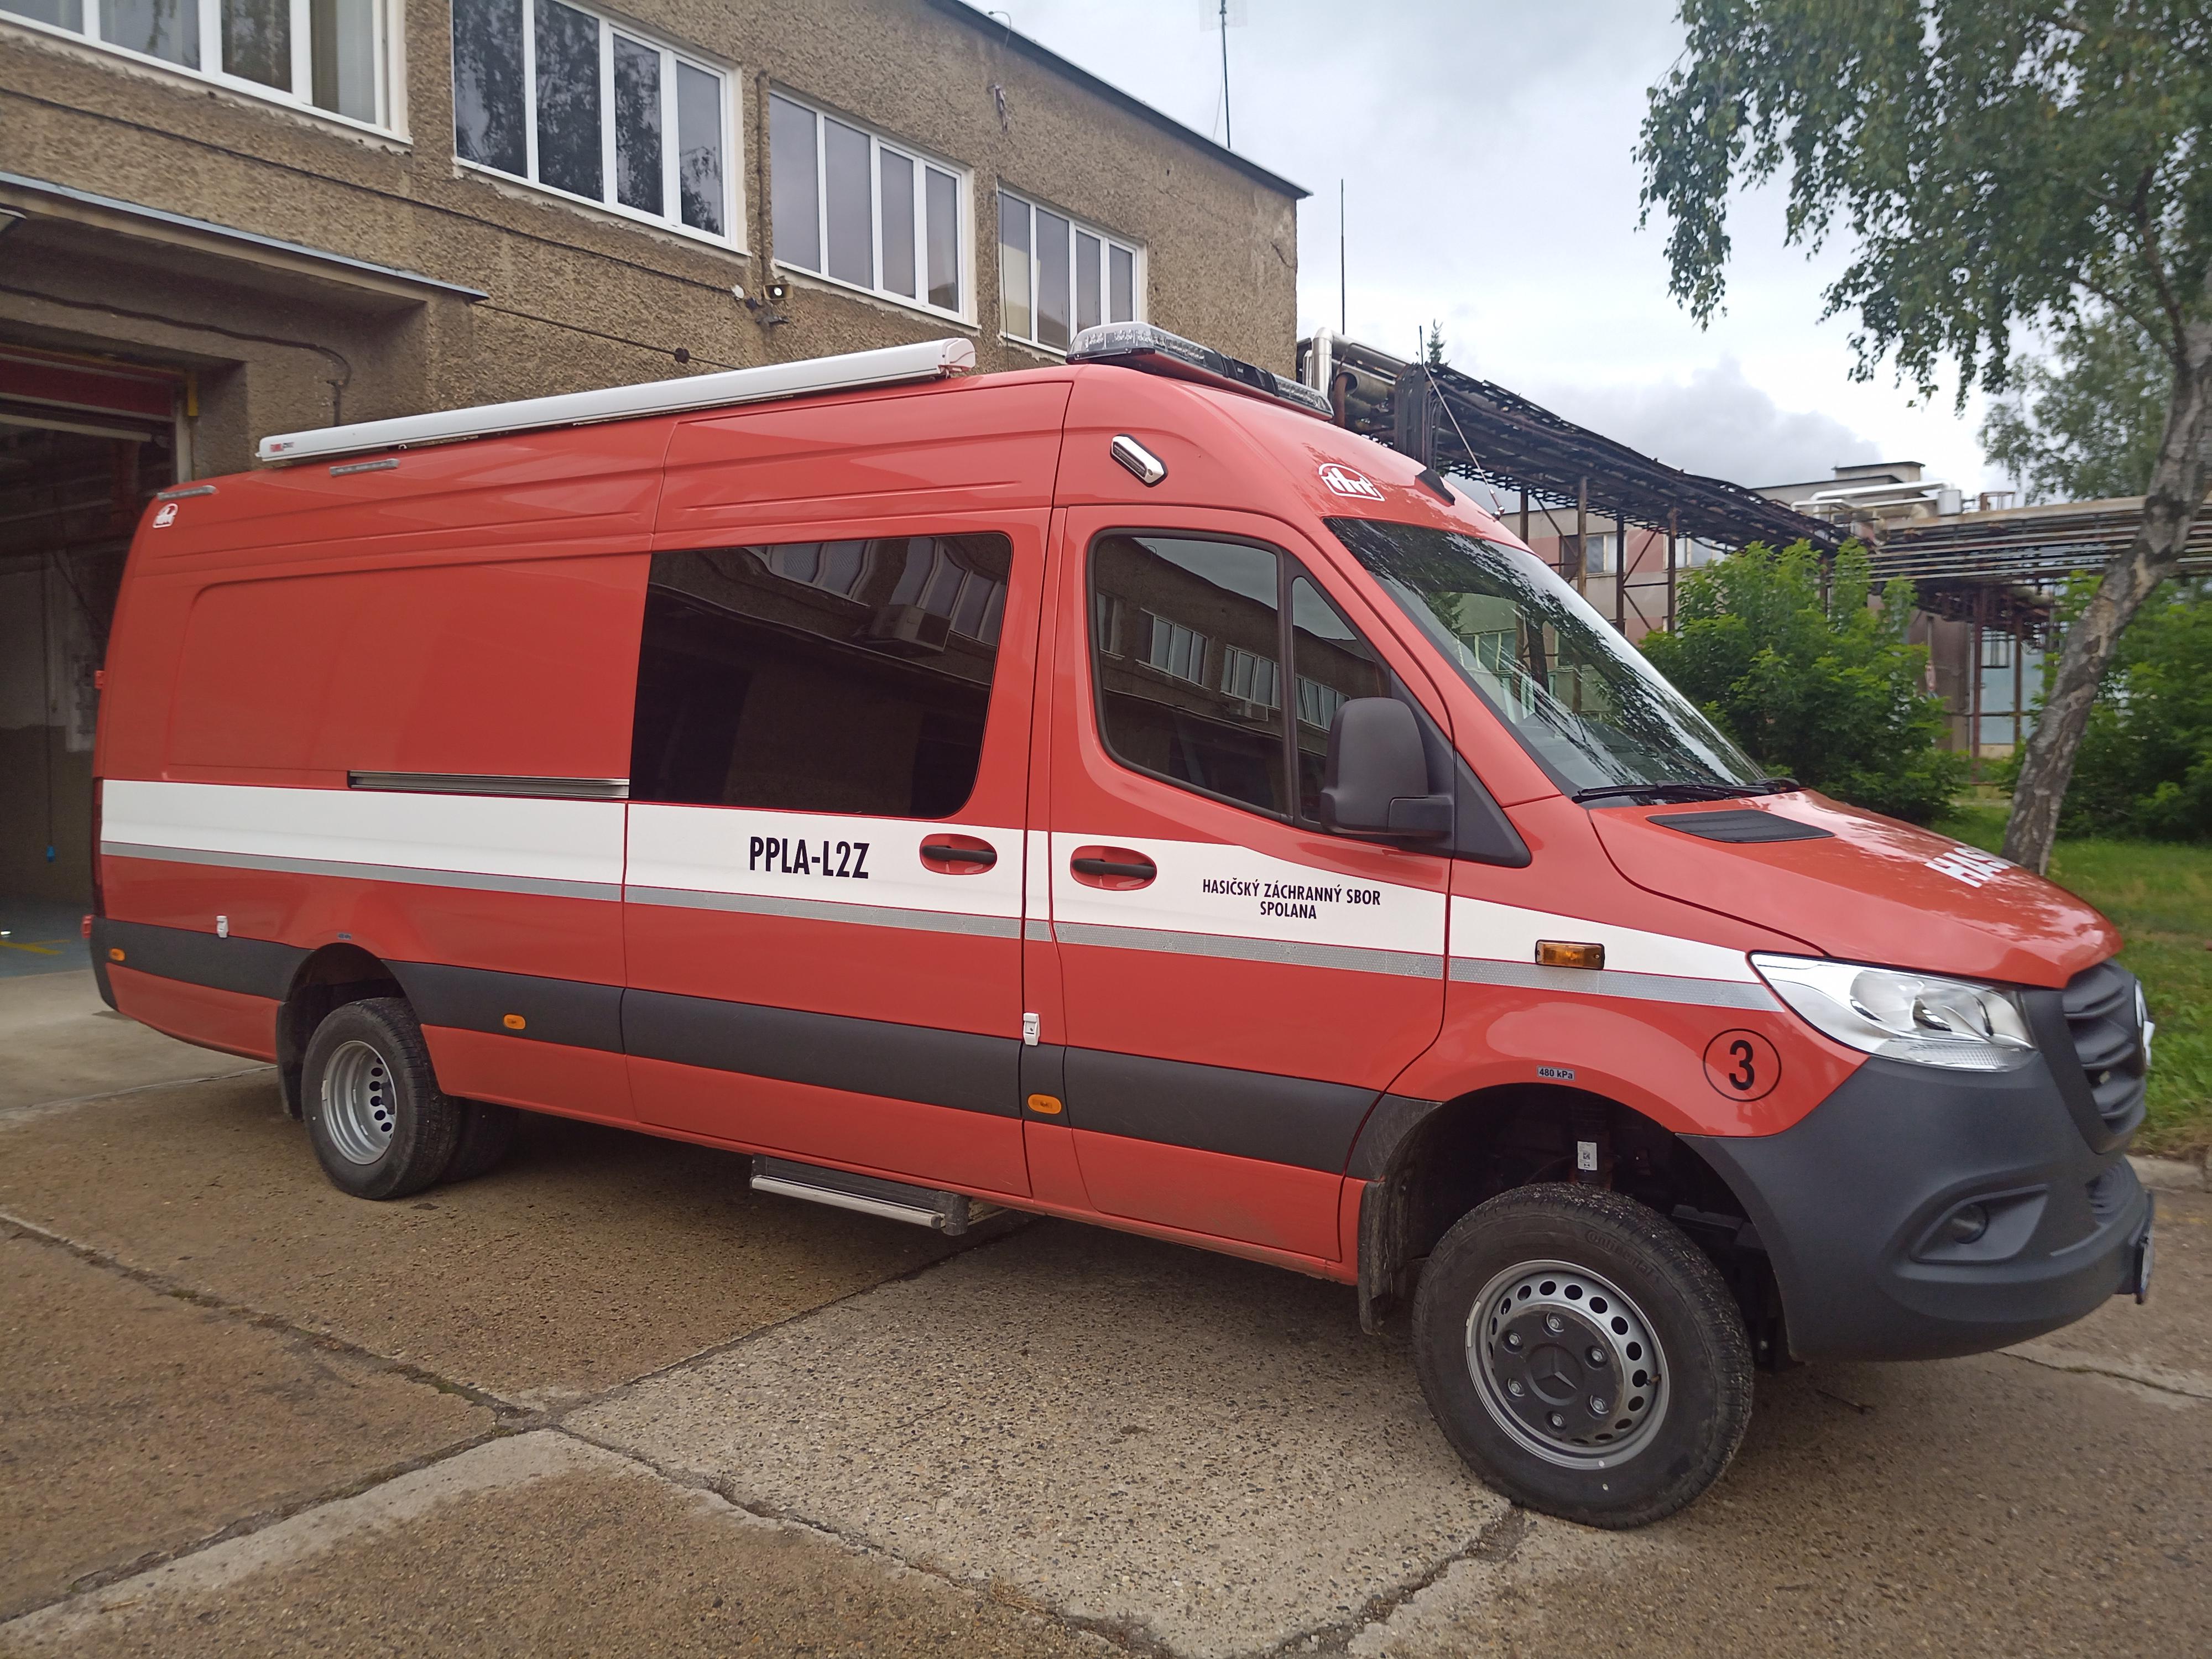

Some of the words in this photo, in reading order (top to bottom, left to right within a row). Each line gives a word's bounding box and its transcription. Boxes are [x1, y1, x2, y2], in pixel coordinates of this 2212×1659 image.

[749, 836, 870, 879] PPLA-L2Z
[1202, 878, 1260, 897] HASIČSKÝ
[1264, 880, 1342, 902] ZÁCHRANNÝ
[1347, 889, 1381, 905] SBOR
[1260, 901, 1317, 919] SPOLANA
[1539, 1068, 1554, 1077] 480
[1557, 1070, 1573, 1079] kPa
[1729, 1040, 1755, 1091] 3
